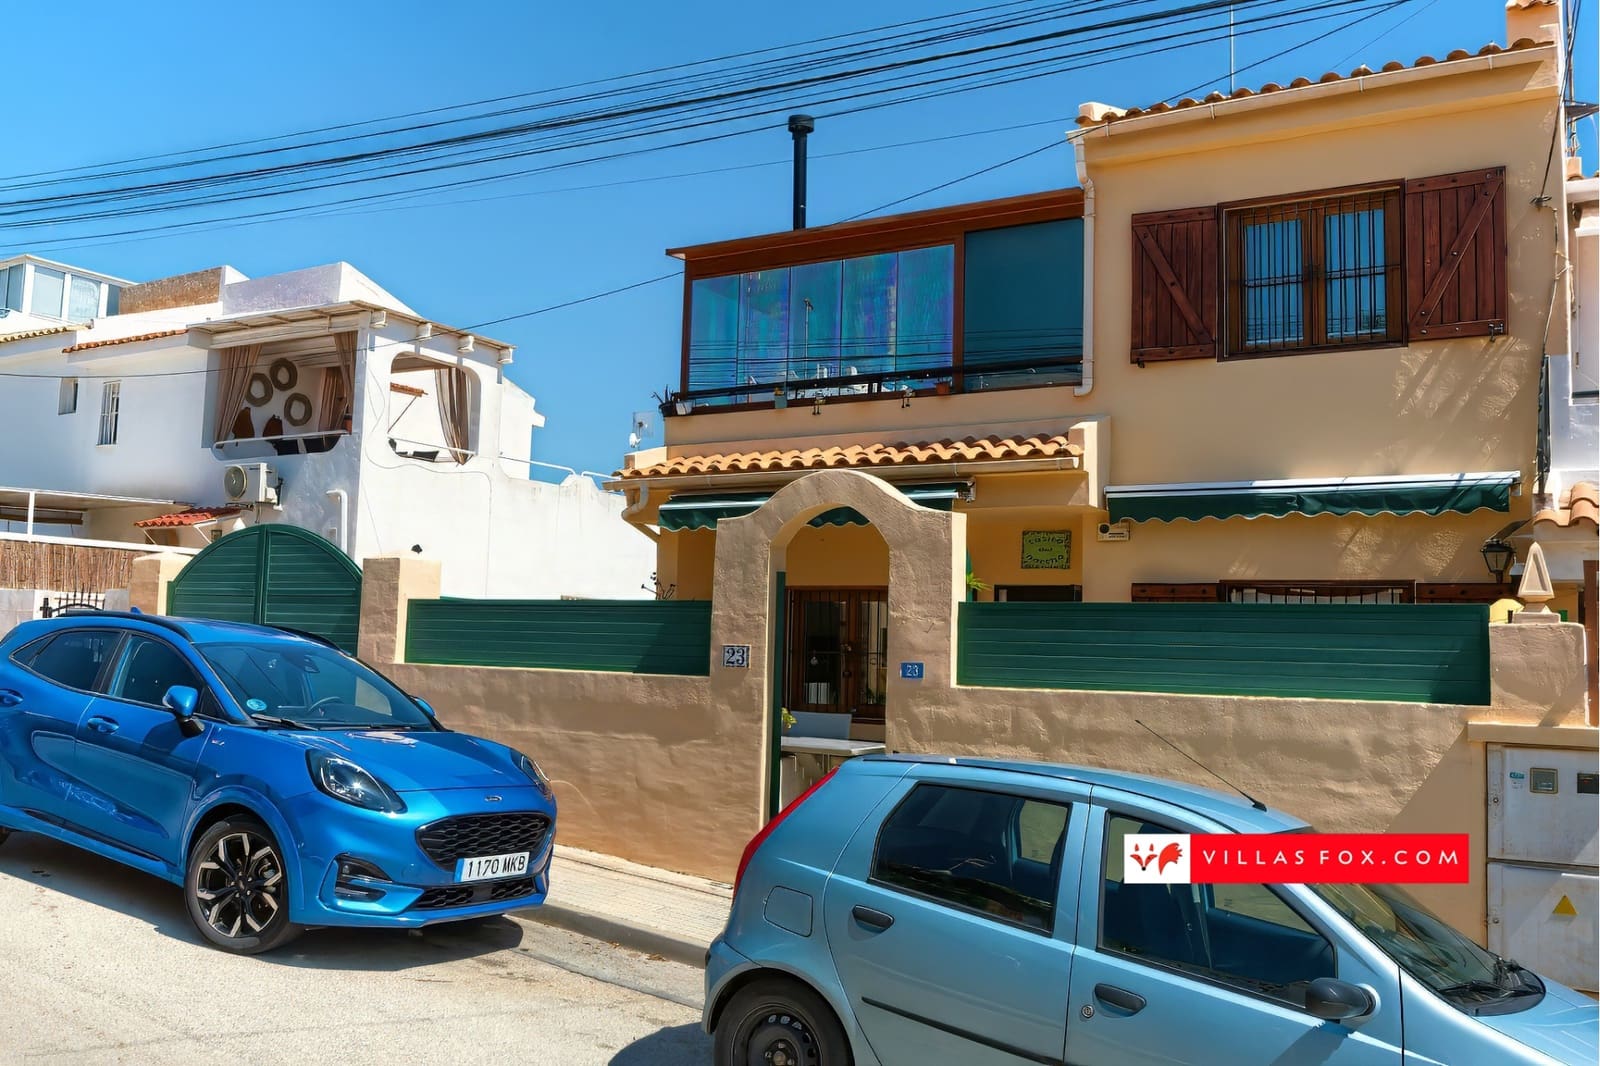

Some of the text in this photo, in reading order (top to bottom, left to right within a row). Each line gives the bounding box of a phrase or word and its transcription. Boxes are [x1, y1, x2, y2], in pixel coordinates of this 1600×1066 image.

[726, 647, 745, 665] 23
[906, 664, 919, 677] 23
[467, 855, 526, 878] 1170 MKB
